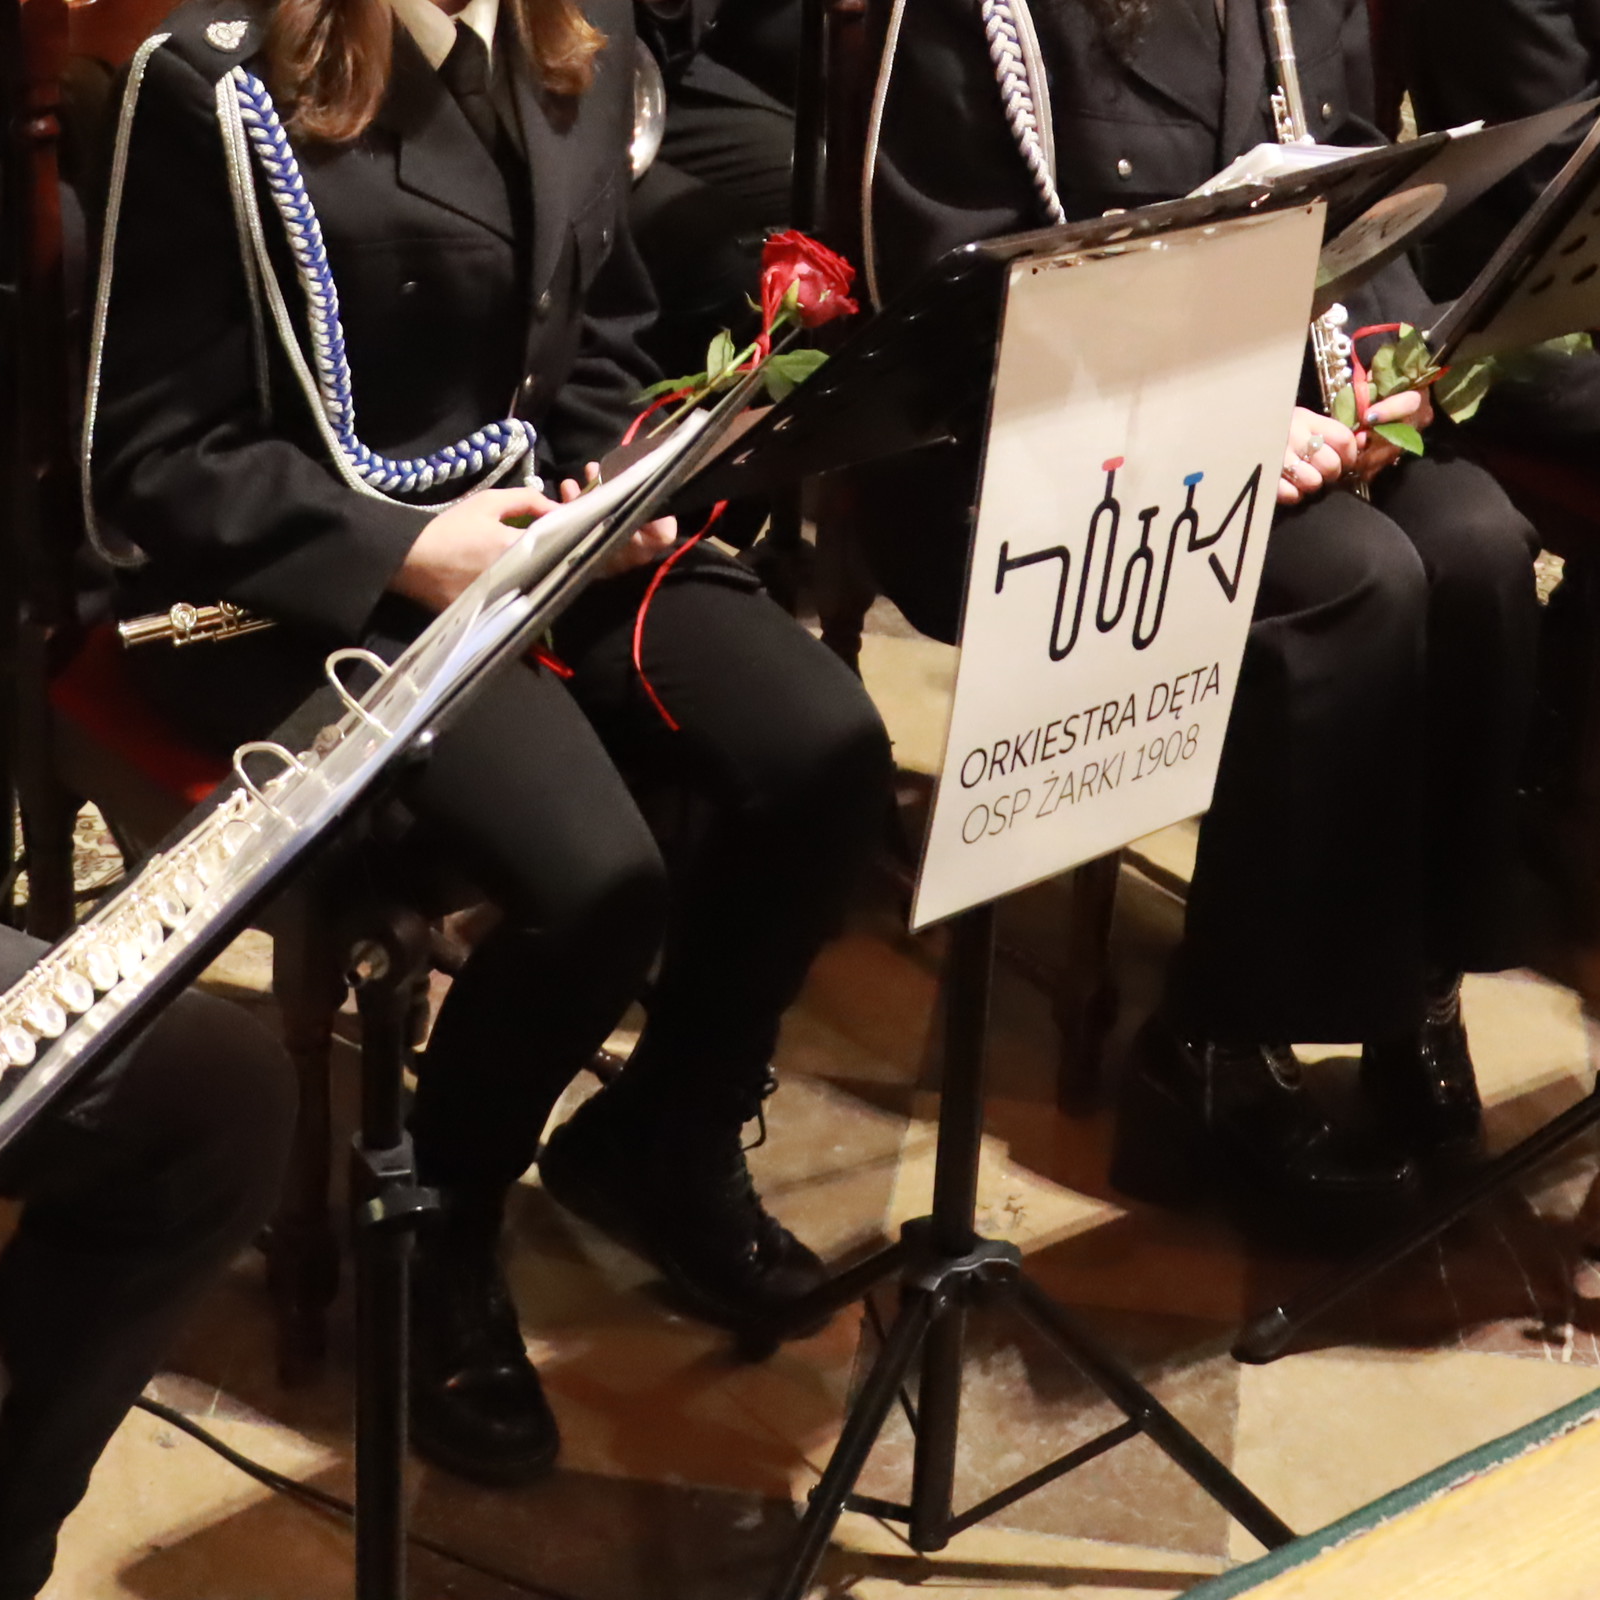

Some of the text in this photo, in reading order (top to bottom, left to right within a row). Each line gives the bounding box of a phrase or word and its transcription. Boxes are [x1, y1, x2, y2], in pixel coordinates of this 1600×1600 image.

[960, 661, 1220, 789] ORKIESTRA DĘTA
[961, 723, 1200, 844] OSP ŻARKI 1908
